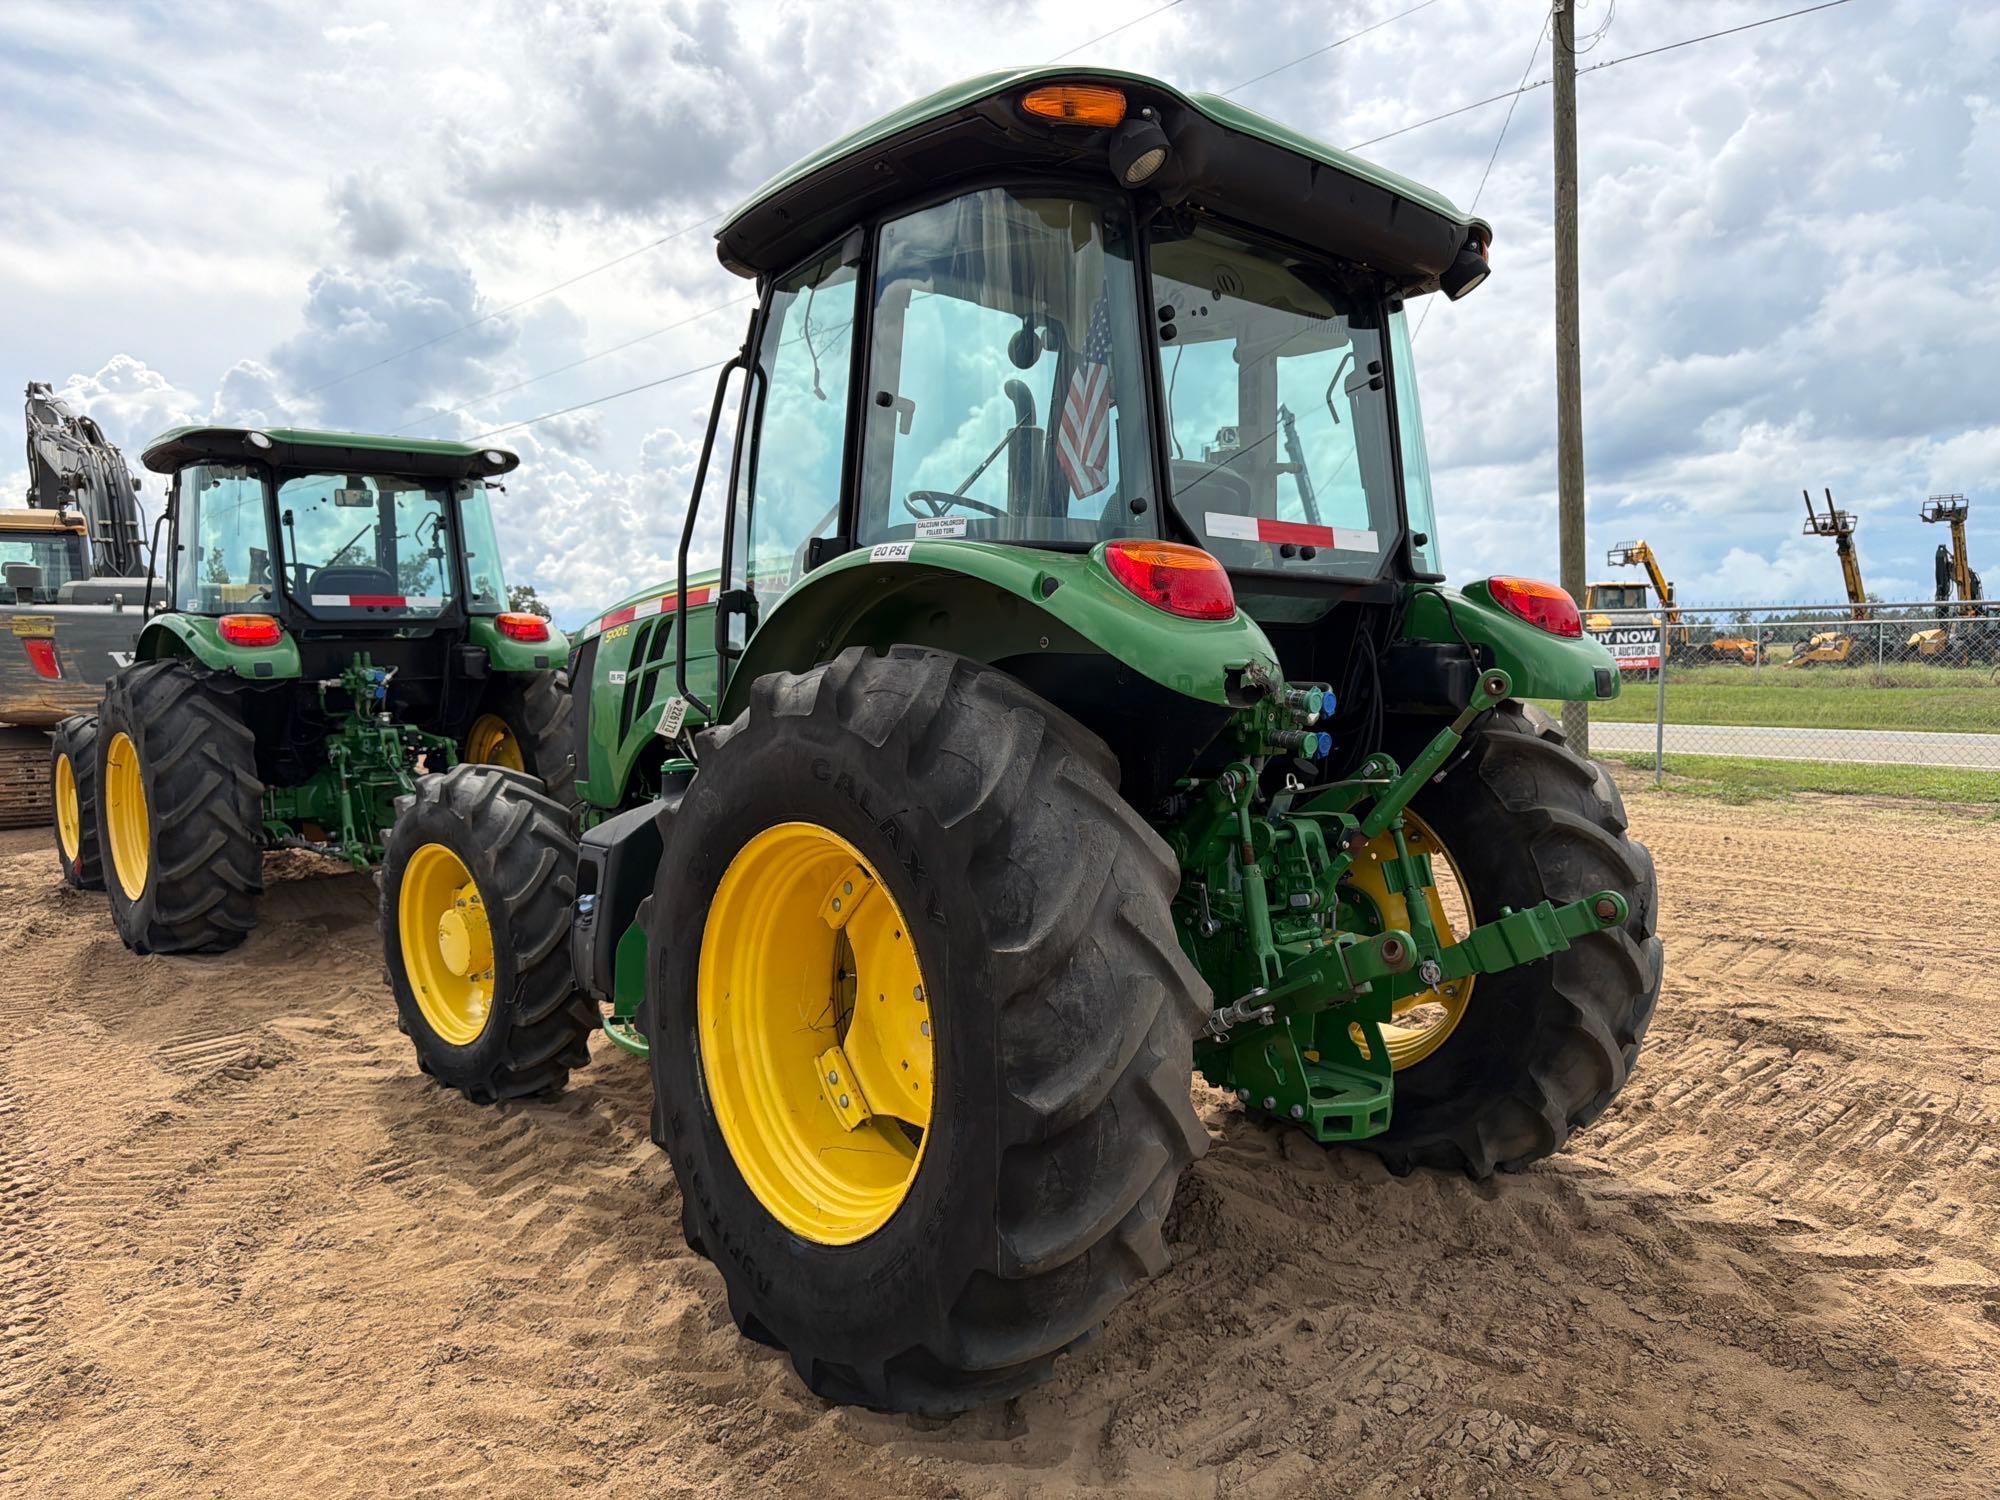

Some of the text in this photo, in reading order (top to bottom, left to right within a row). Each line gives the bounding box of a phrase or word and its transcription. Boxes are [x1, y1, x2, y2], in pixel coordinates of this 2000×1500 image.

[917, 518, 965, 529] CALCIUM CHLORIDE
[926, 528, 943, 536] FILLED
[874, 545, 909, 557] 20 PSI
[1592, 630, 1656, 644] UY NOW
[1618, 645, 1646, 657] AUCTION
[810, 758, 949, 928] GALAXY
